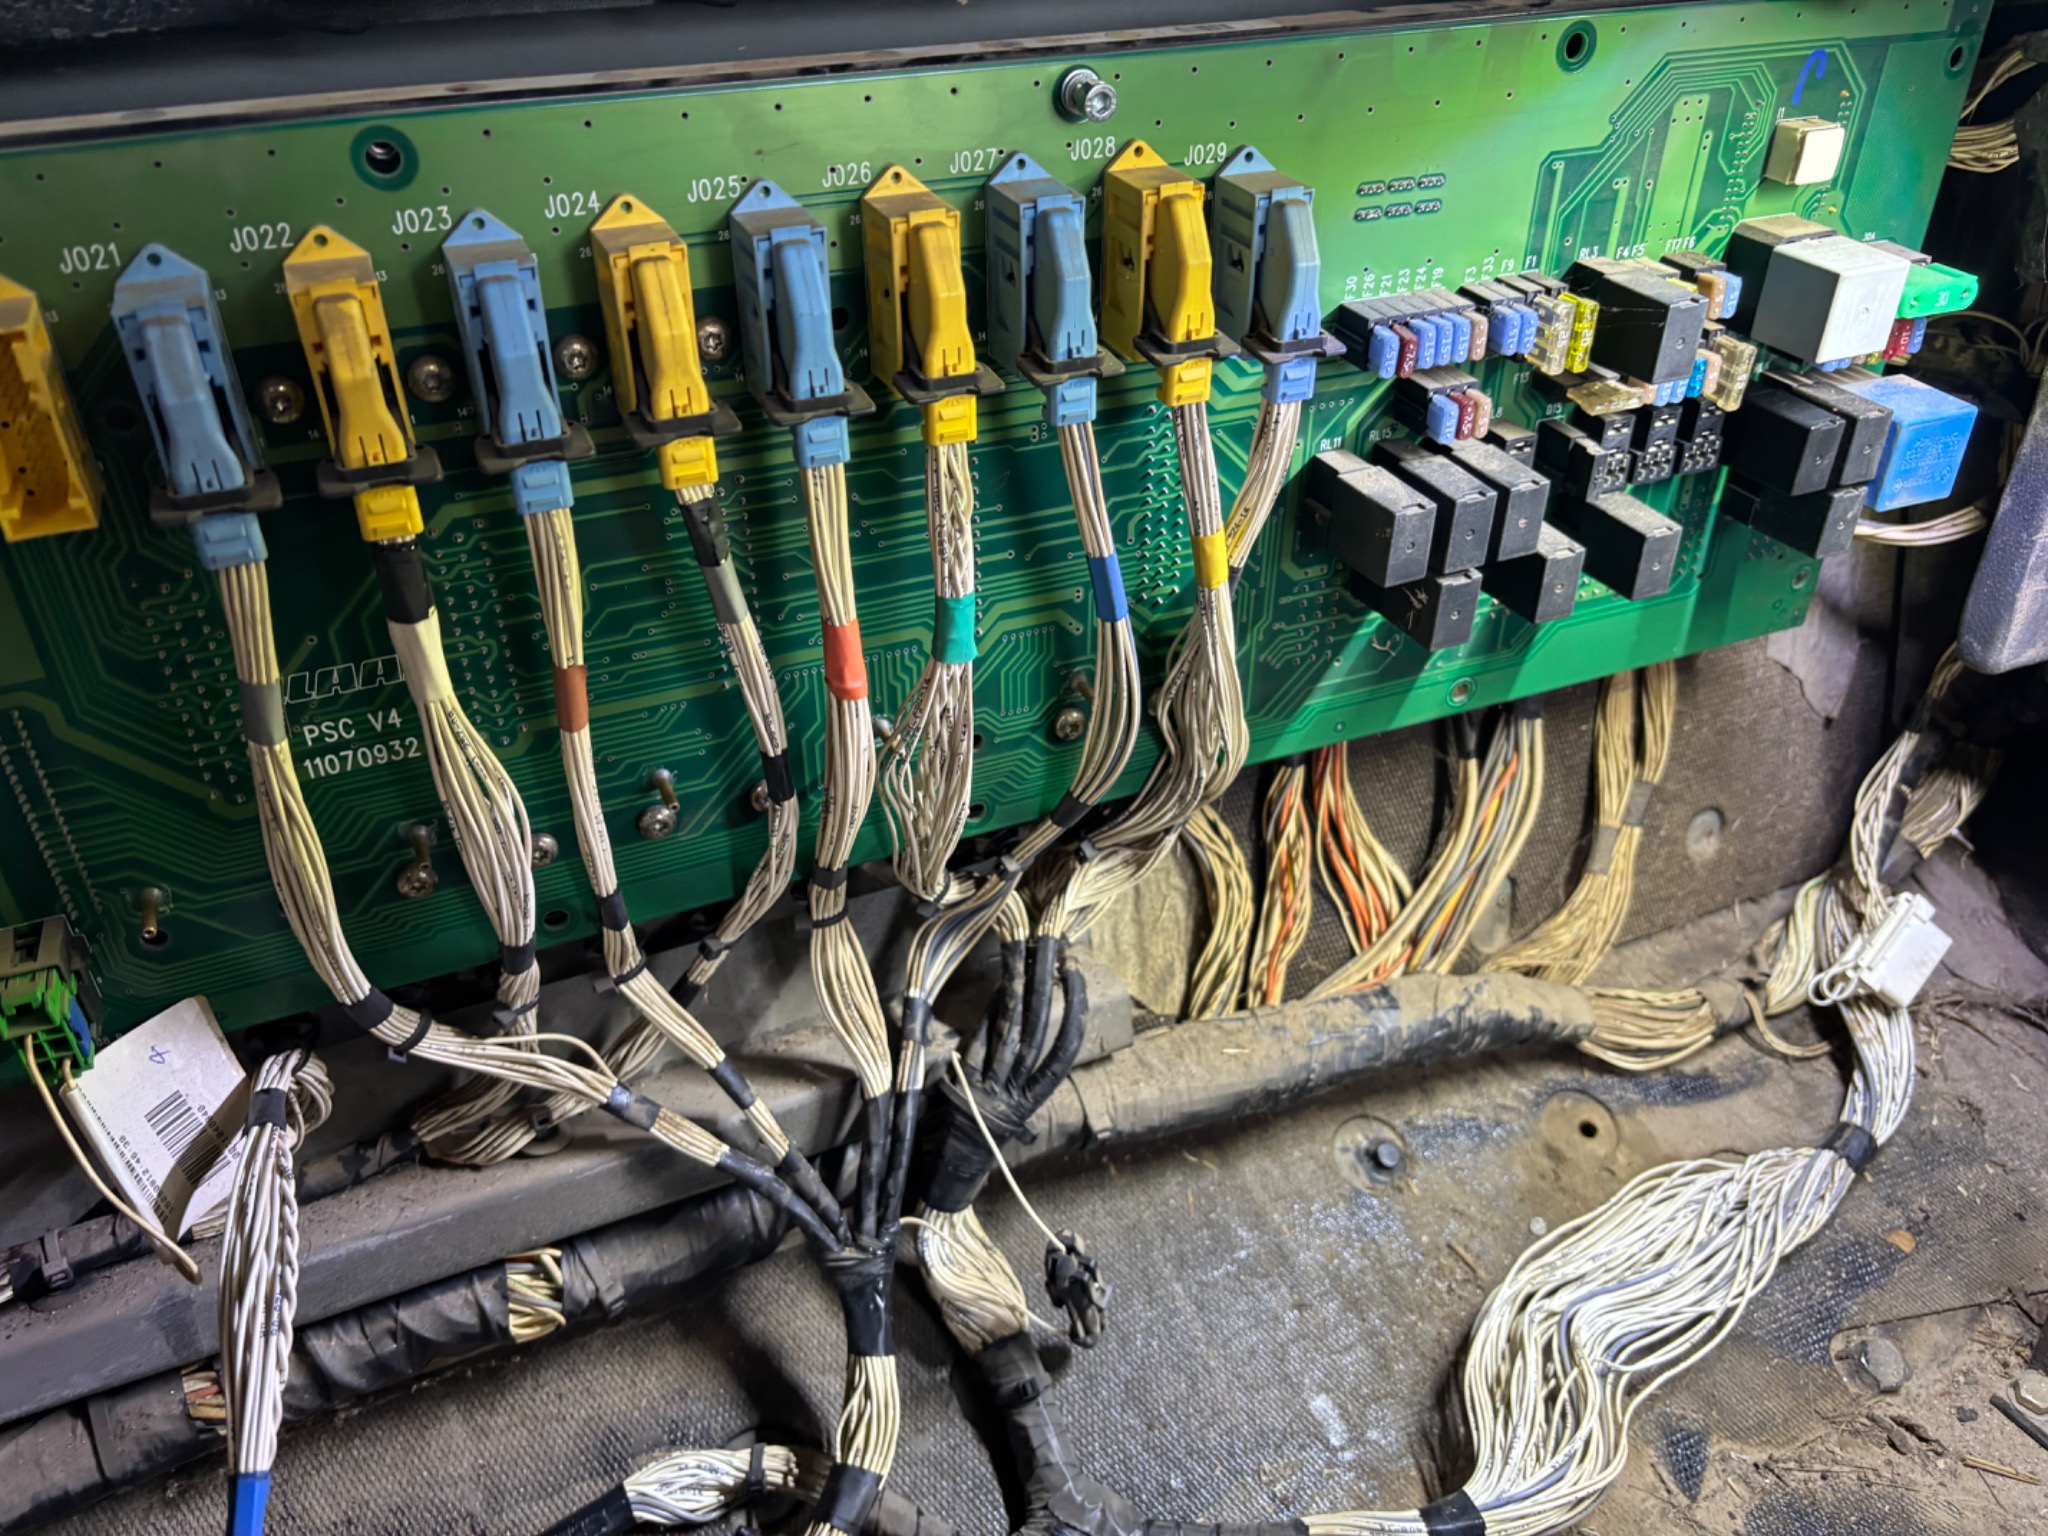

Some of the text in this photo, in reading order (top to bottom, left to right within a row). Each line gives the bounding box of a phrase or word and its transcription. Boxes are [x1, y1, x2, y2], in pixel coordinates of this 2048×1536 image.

[949, 147, 998, 174] J027
[1070, 135, 1116, 161] J028
[1184, 141, 1228, 166] J029
[823, 161, 872, 188] J026
[687, 174, 741, 203] J025
[544, 189, 602, 220] J024
[391, 204, 453, 235] J023
[229, 222, 295, 254] J022
[1631, 243, 1646, 257] F5
[59, 241, 122, 275] J021
[1500, 258, 1515, 272] F9
[1525, 255, 1537, 269] F1
[1616, 247, 1630, 259] F4
[1464, 266, 1477, 283] F3
[1481, 255, 1494, 281] F33
[1344, 275, 1358, 301] F30
[302, 707, 403, 747] PSC V4
[303, 736, 422, 779] 11070932
